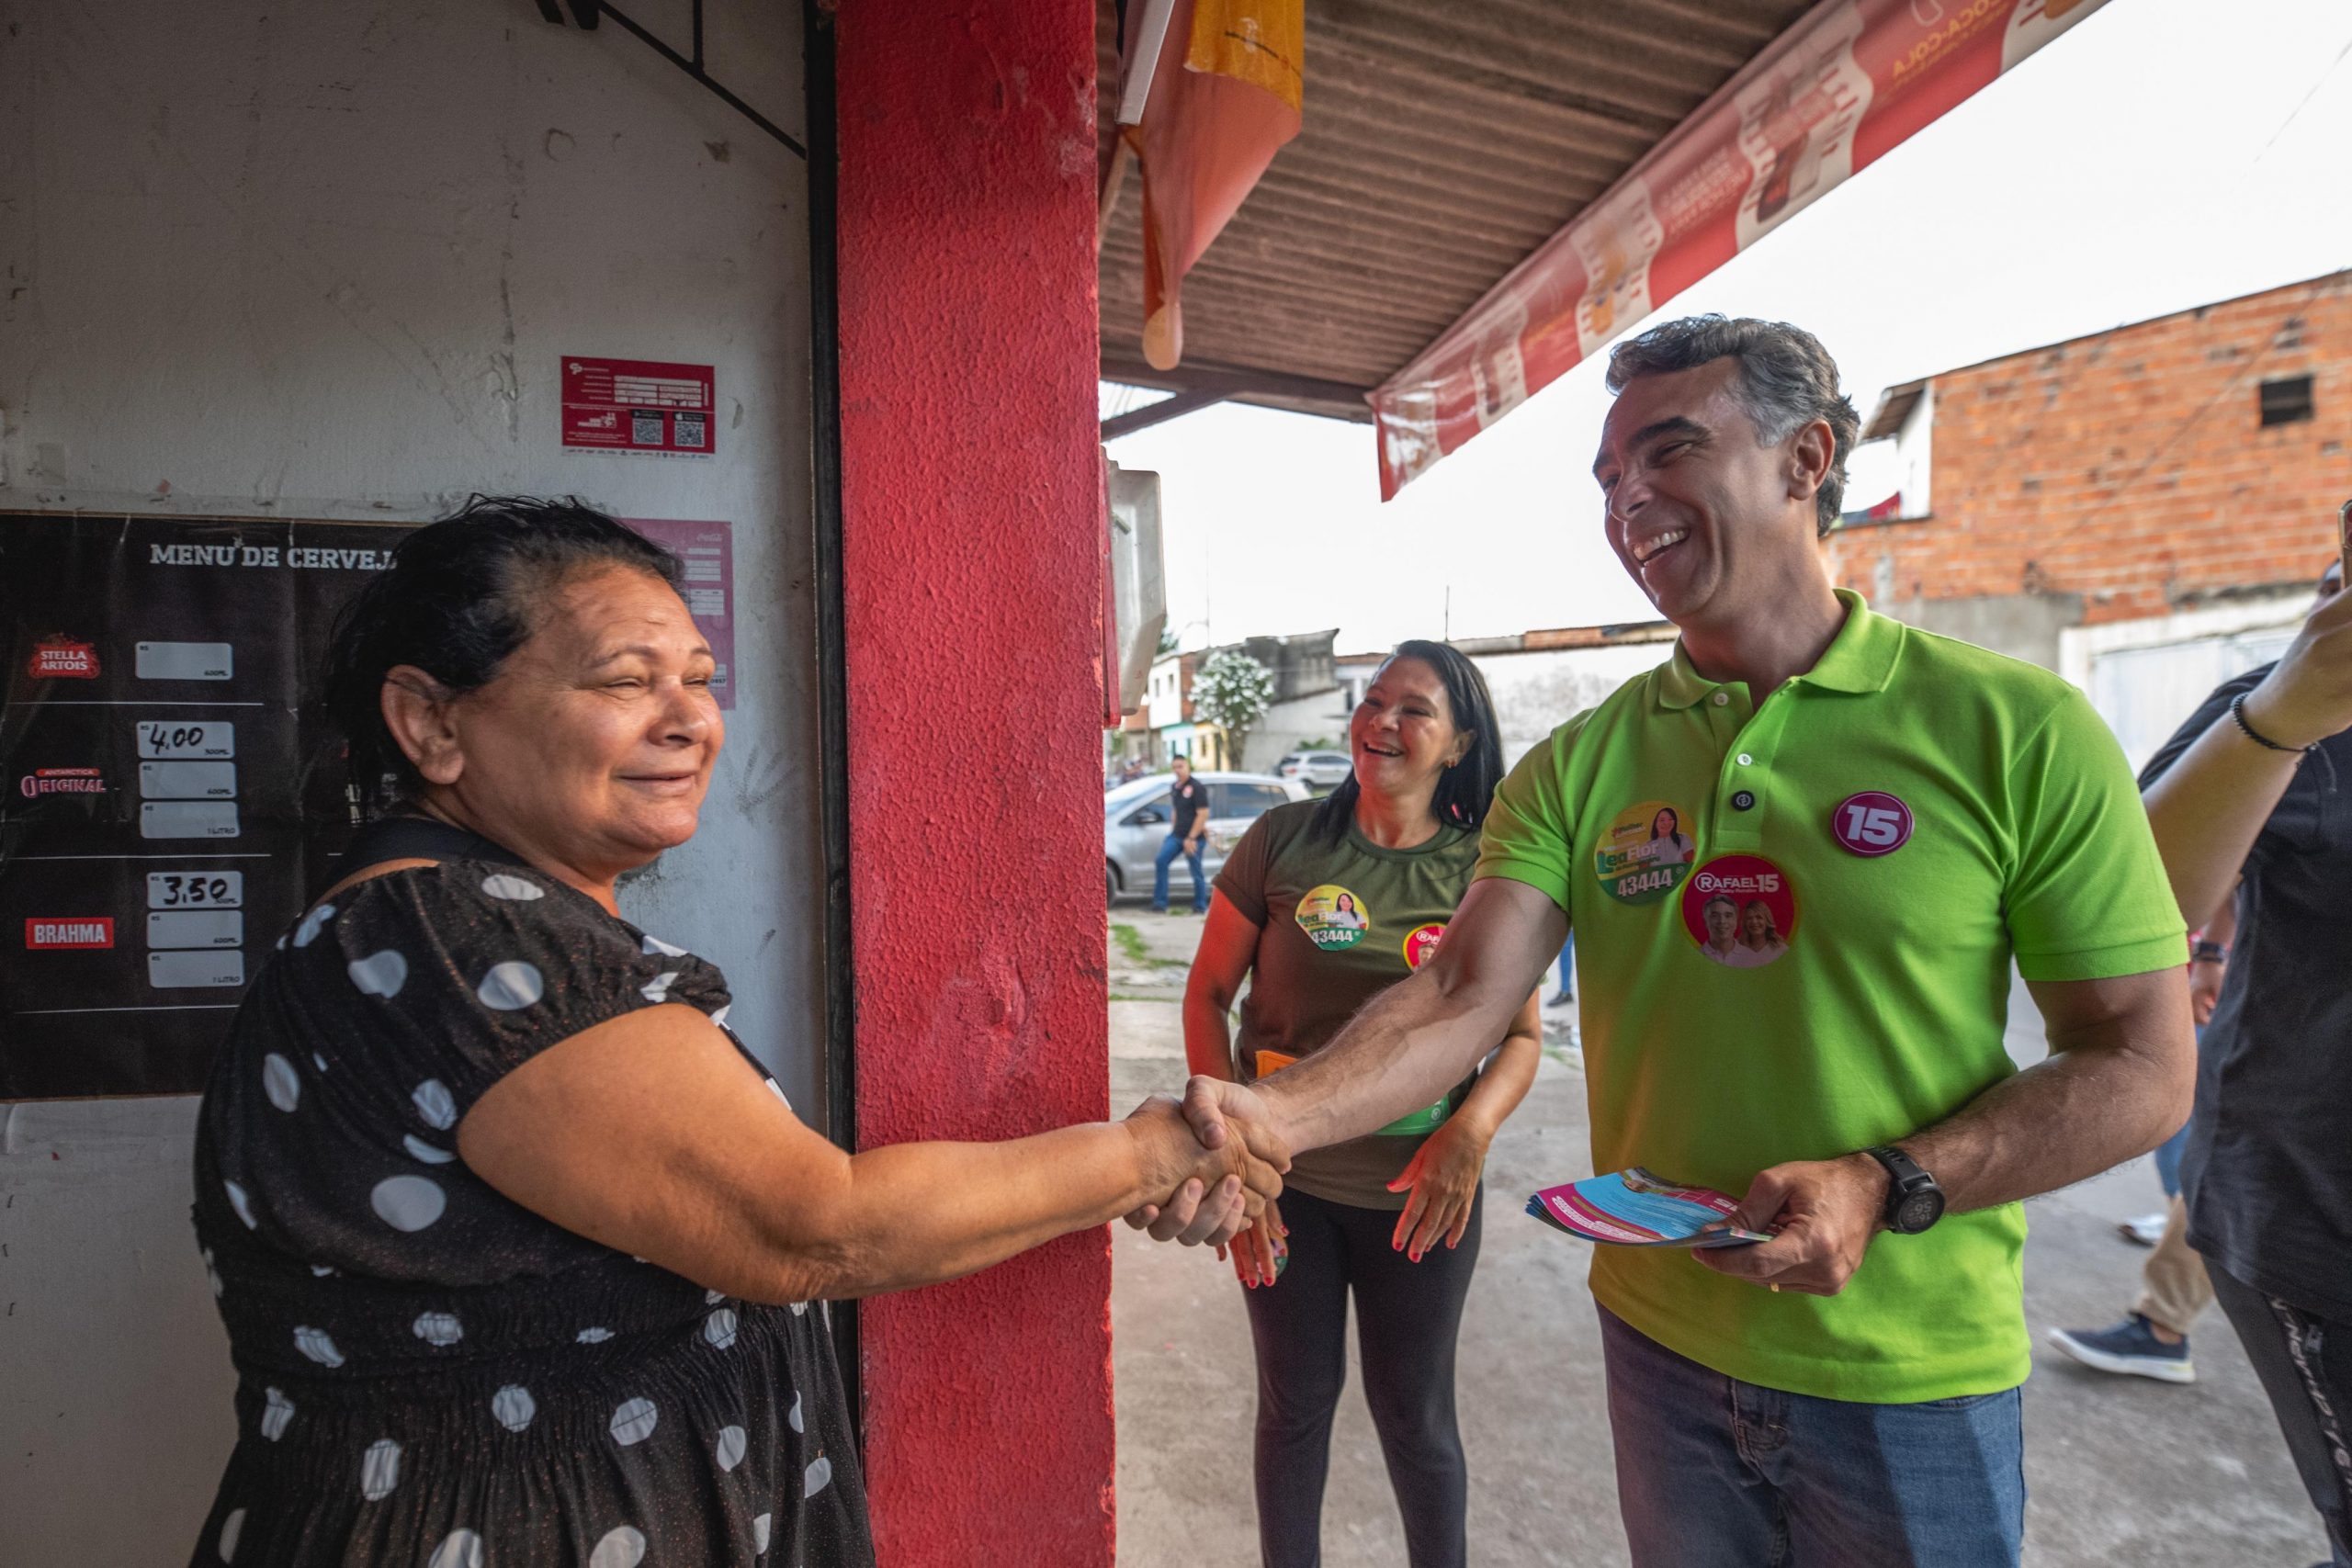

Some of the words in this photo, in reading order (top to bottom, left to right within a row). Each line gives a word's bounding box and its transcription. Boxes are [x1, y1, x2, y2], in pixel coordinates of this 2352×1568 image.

[150, 544, 233, 566] MENU
[242, 547, 279, 567] DE
[287, 547, 397, 570] CERVEJ
[40, 650, 87, 660] STELLA
[40, 660, 88, 671] ARTOIS
[20, 775, 106, 798] ORIGINAL
[1847, 805, 1900, 845] 15
[1618, 868, 1673, 897] 43444
[1696, 874, 1758, 891] RAFAEL
[1757, 874, 1780, 892] 15
[34, 924, 106, 943] BRAHMA
